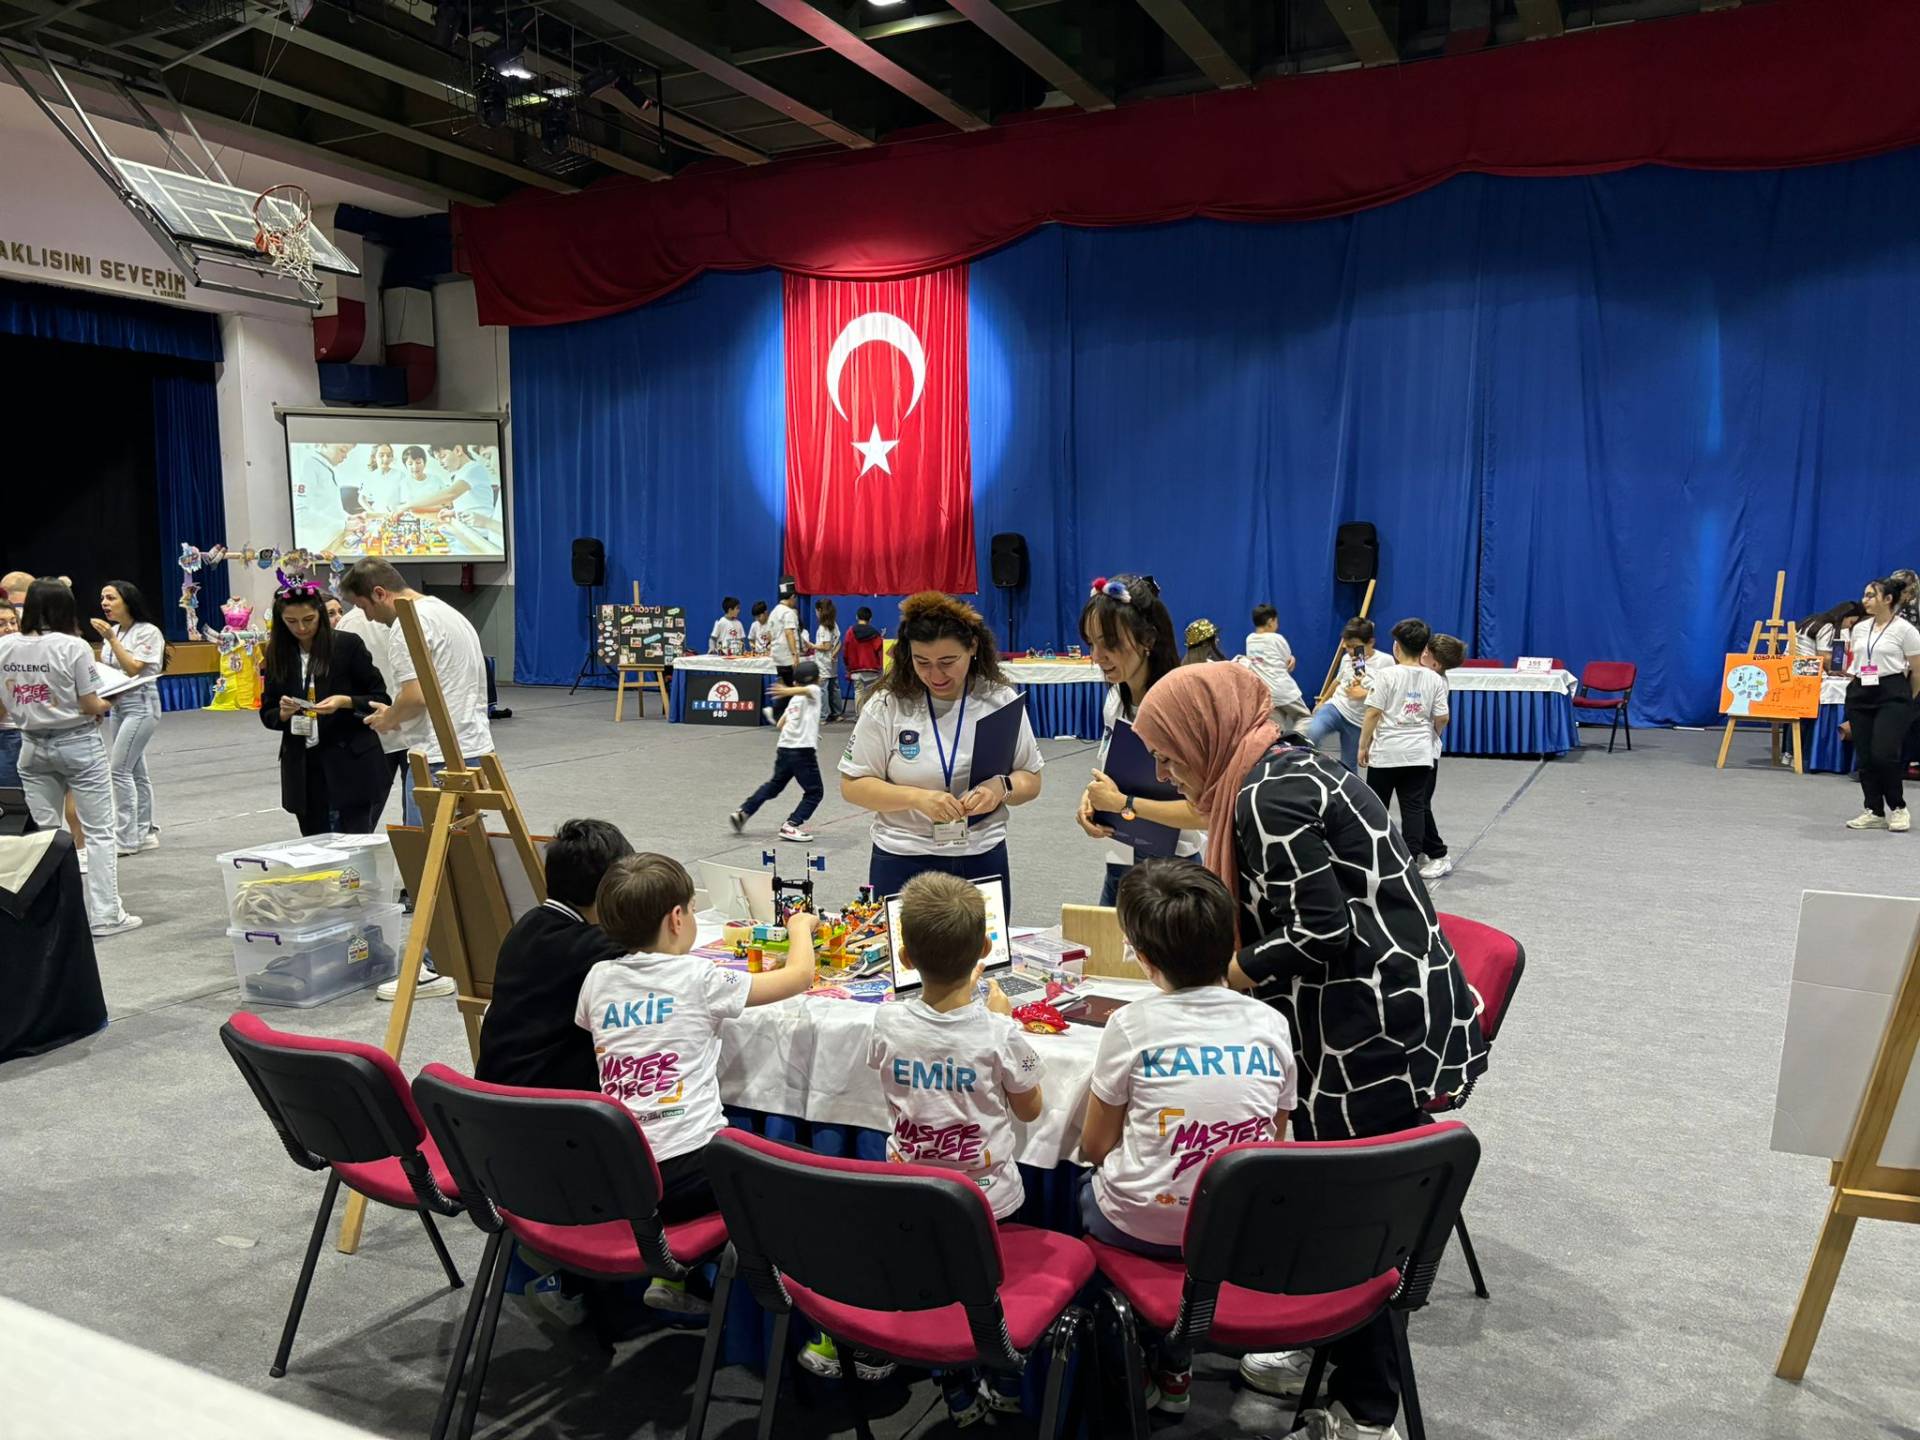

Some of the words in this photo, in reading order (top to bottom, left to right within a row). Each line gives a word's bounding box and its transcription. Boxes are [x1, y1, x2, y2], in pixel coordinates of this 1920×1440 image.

[100, 259, 186, 293] SEVERİM
[602, 993, 674, 1030] AKİF
[893, 1056, 977, 1093] EMİR
[1141, 1045, 1281, 1078] KARTAL
[894, 1118, 981, 1152] MASTER
